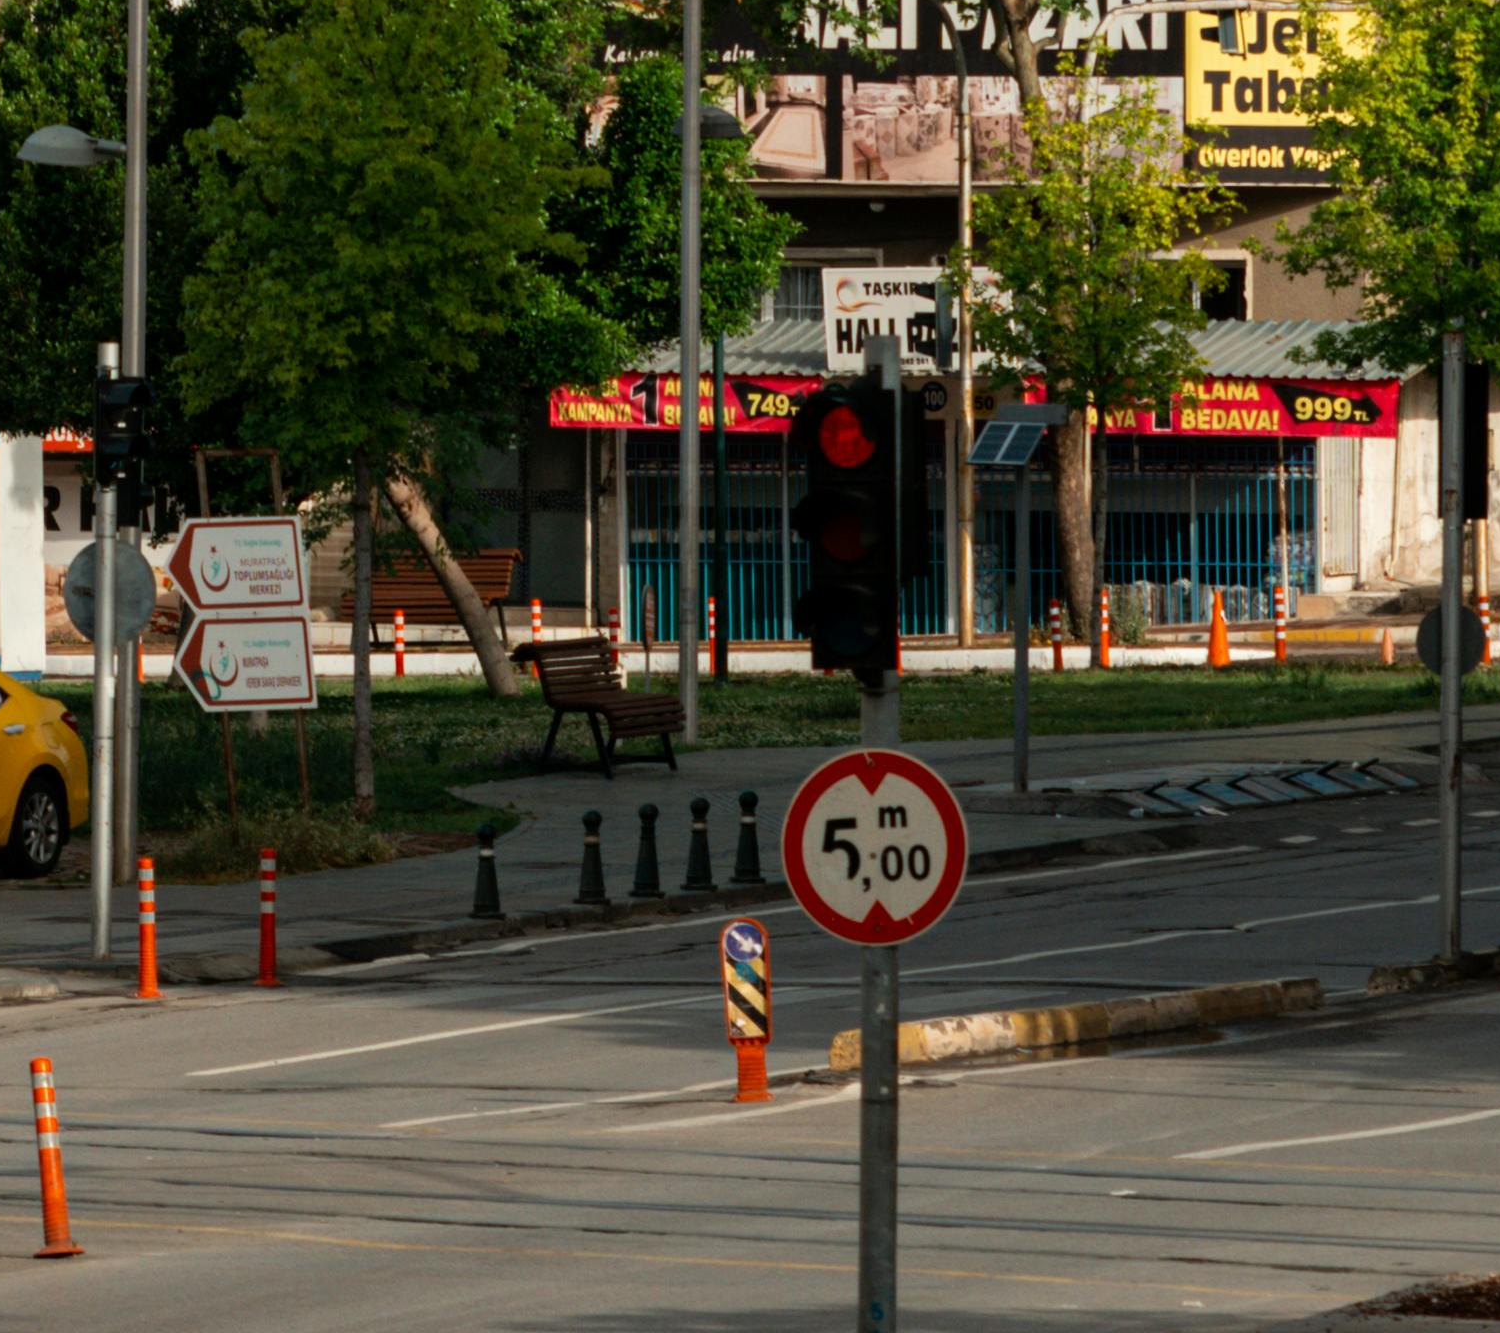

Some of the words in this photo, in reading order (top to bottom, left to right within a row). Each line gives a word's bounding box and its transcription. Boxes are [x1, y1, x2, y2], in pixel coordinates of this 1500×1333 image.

[1203, 69, 1348, 113] Taba
[1198, 145, 1285, 168] Overlok
[630, 373, 659, 426] 1
[924, 390, 945, 404] 100
[1181, 381, 1259, 401] ALANA
[558, 402, 633, 422] KAMPANYA
[1181, 409, 1279, 431] BEDAVA!
[240, 557, 287, 568] MURATPAŞA
[877, 805, 908, 829] m
